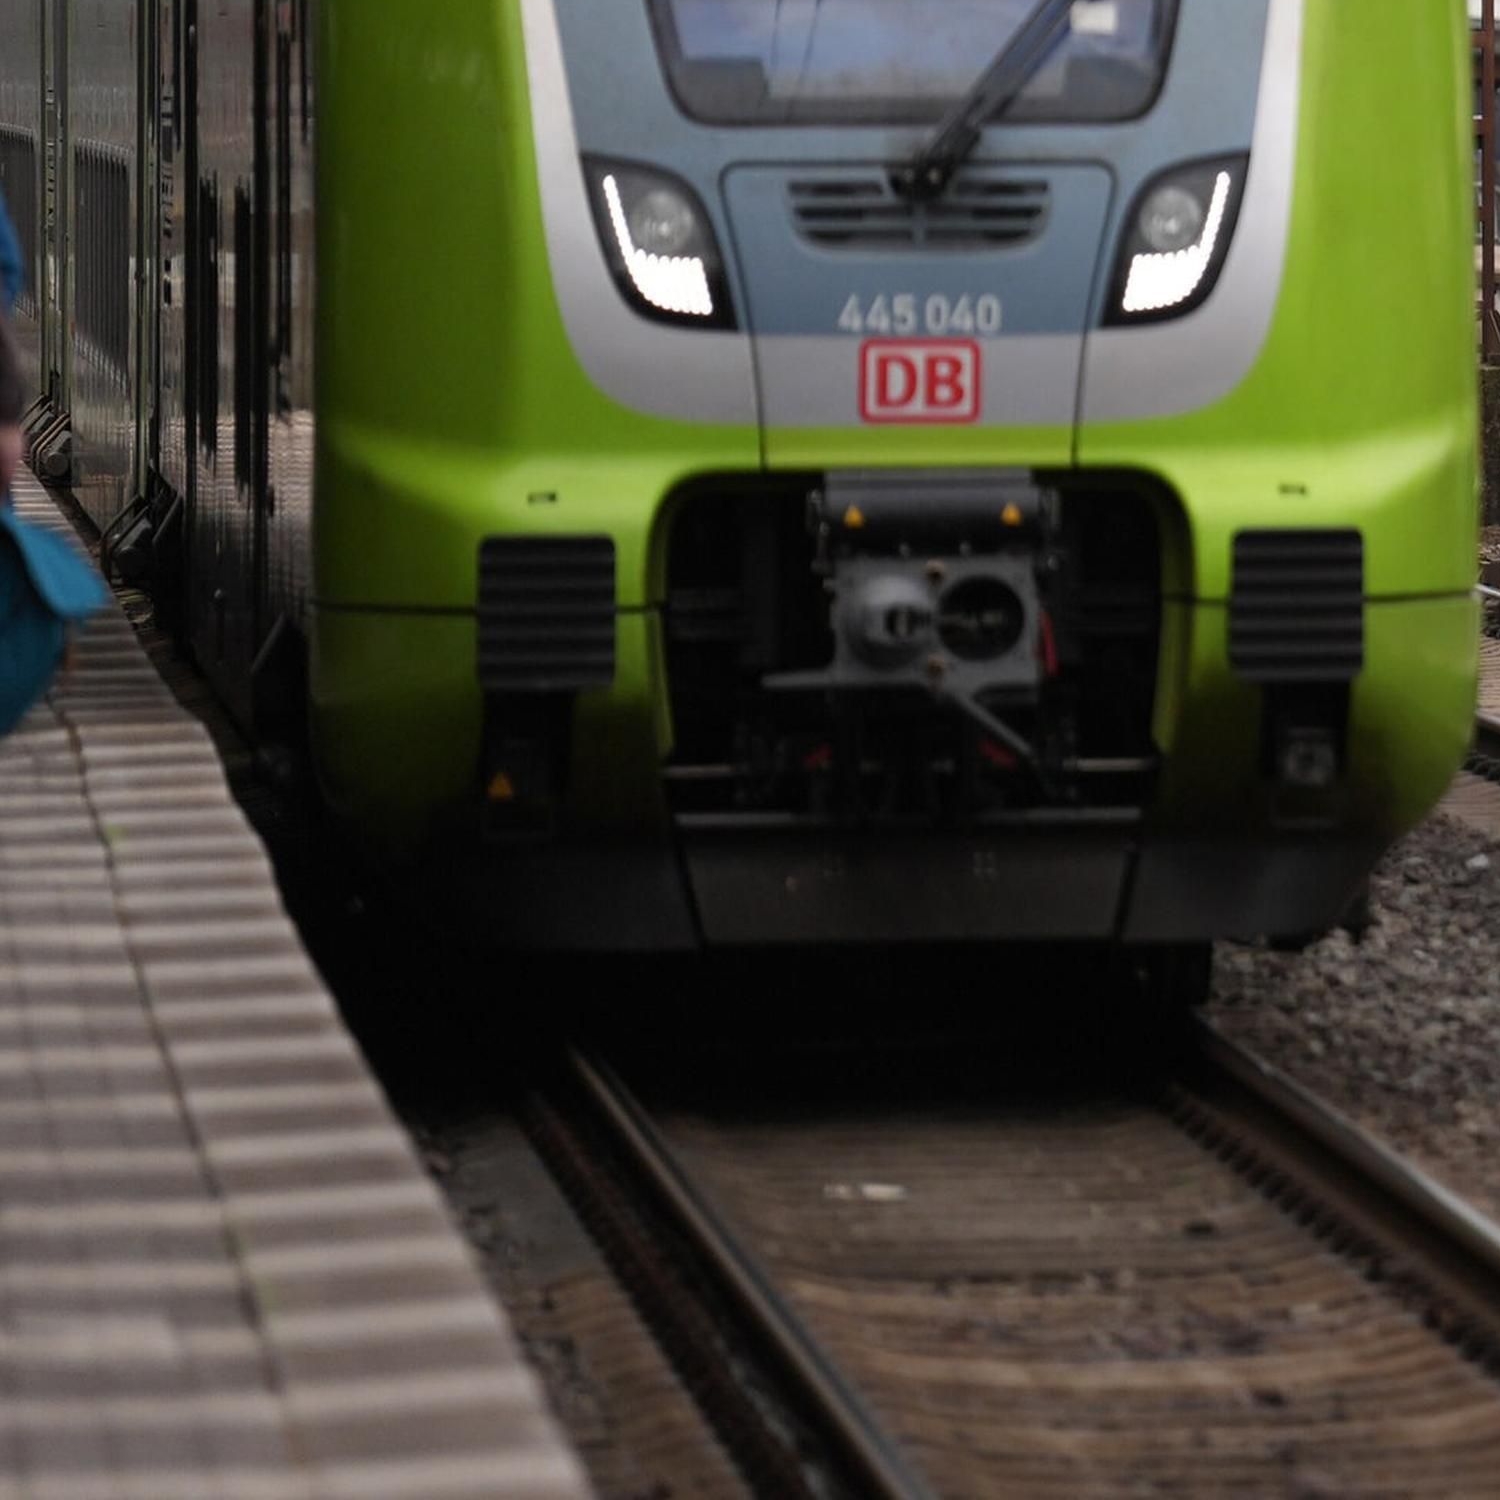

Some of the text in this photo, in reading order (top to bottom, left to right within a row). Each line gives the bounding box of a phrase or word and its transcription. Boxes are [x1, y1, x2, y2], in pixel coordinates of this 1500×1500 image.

[838, 293, 1003, 334] 445 040
[874, 354, 966, 409] DB
